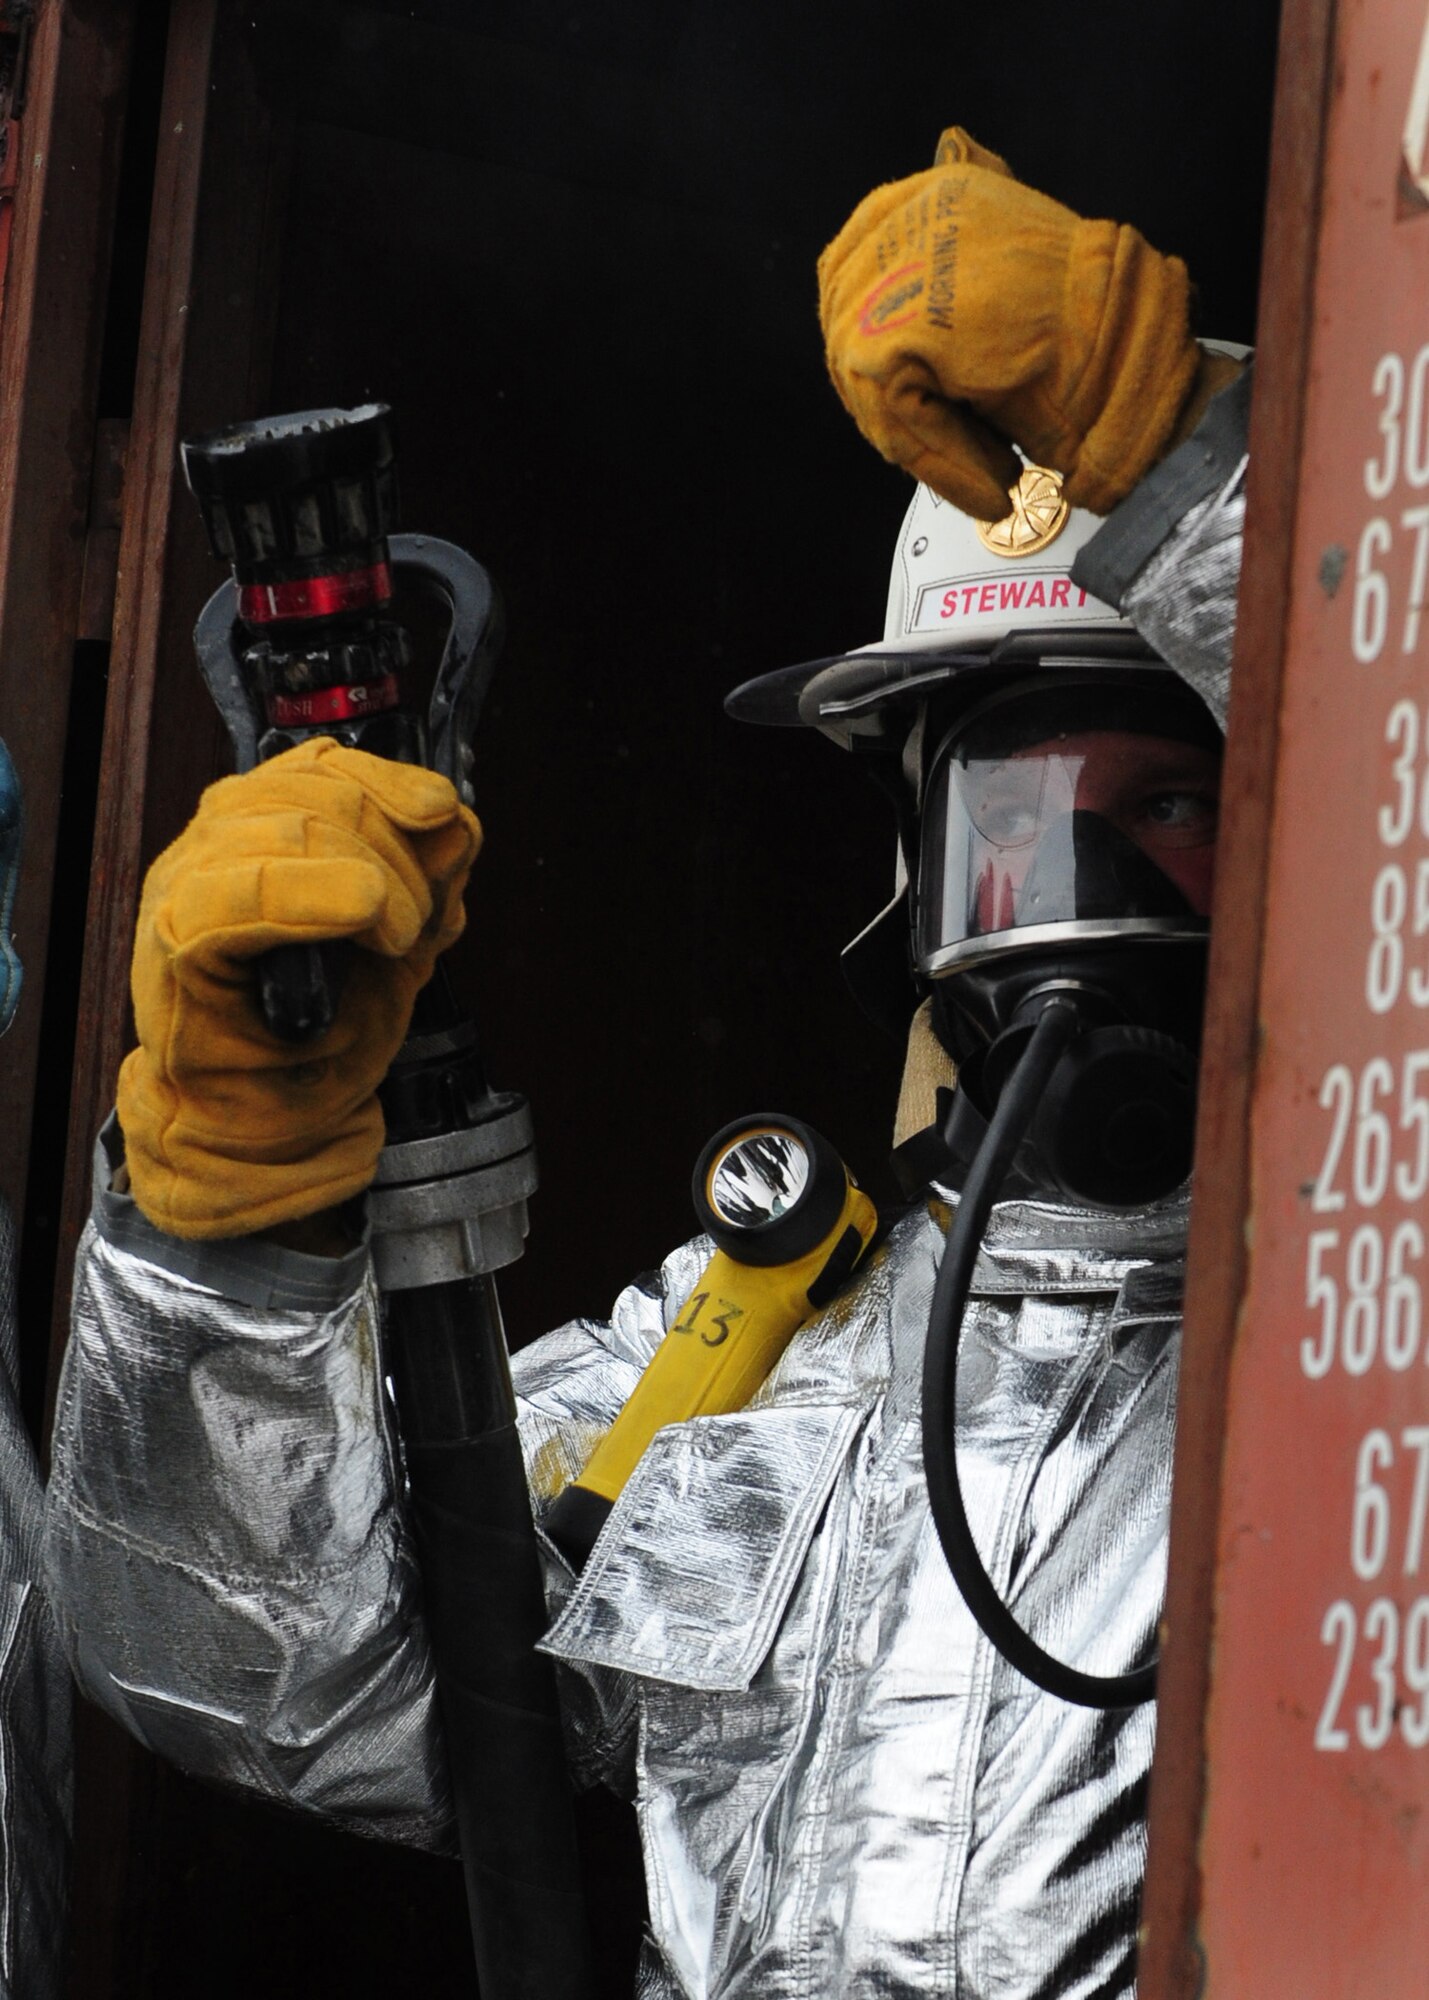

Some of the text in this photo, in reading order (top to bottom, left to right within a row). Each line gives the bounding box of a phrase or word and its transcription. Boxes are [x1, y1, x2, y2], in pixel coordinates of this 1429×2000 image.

[1351, 506, 1429, 663] 67
[1312, 1050, 1429, 1213] 265
[673, 1291, 744, 1348] 13
[1351, 1426, 1429, 1580] 67
[1314, 1596, 1429, 1751] 239
